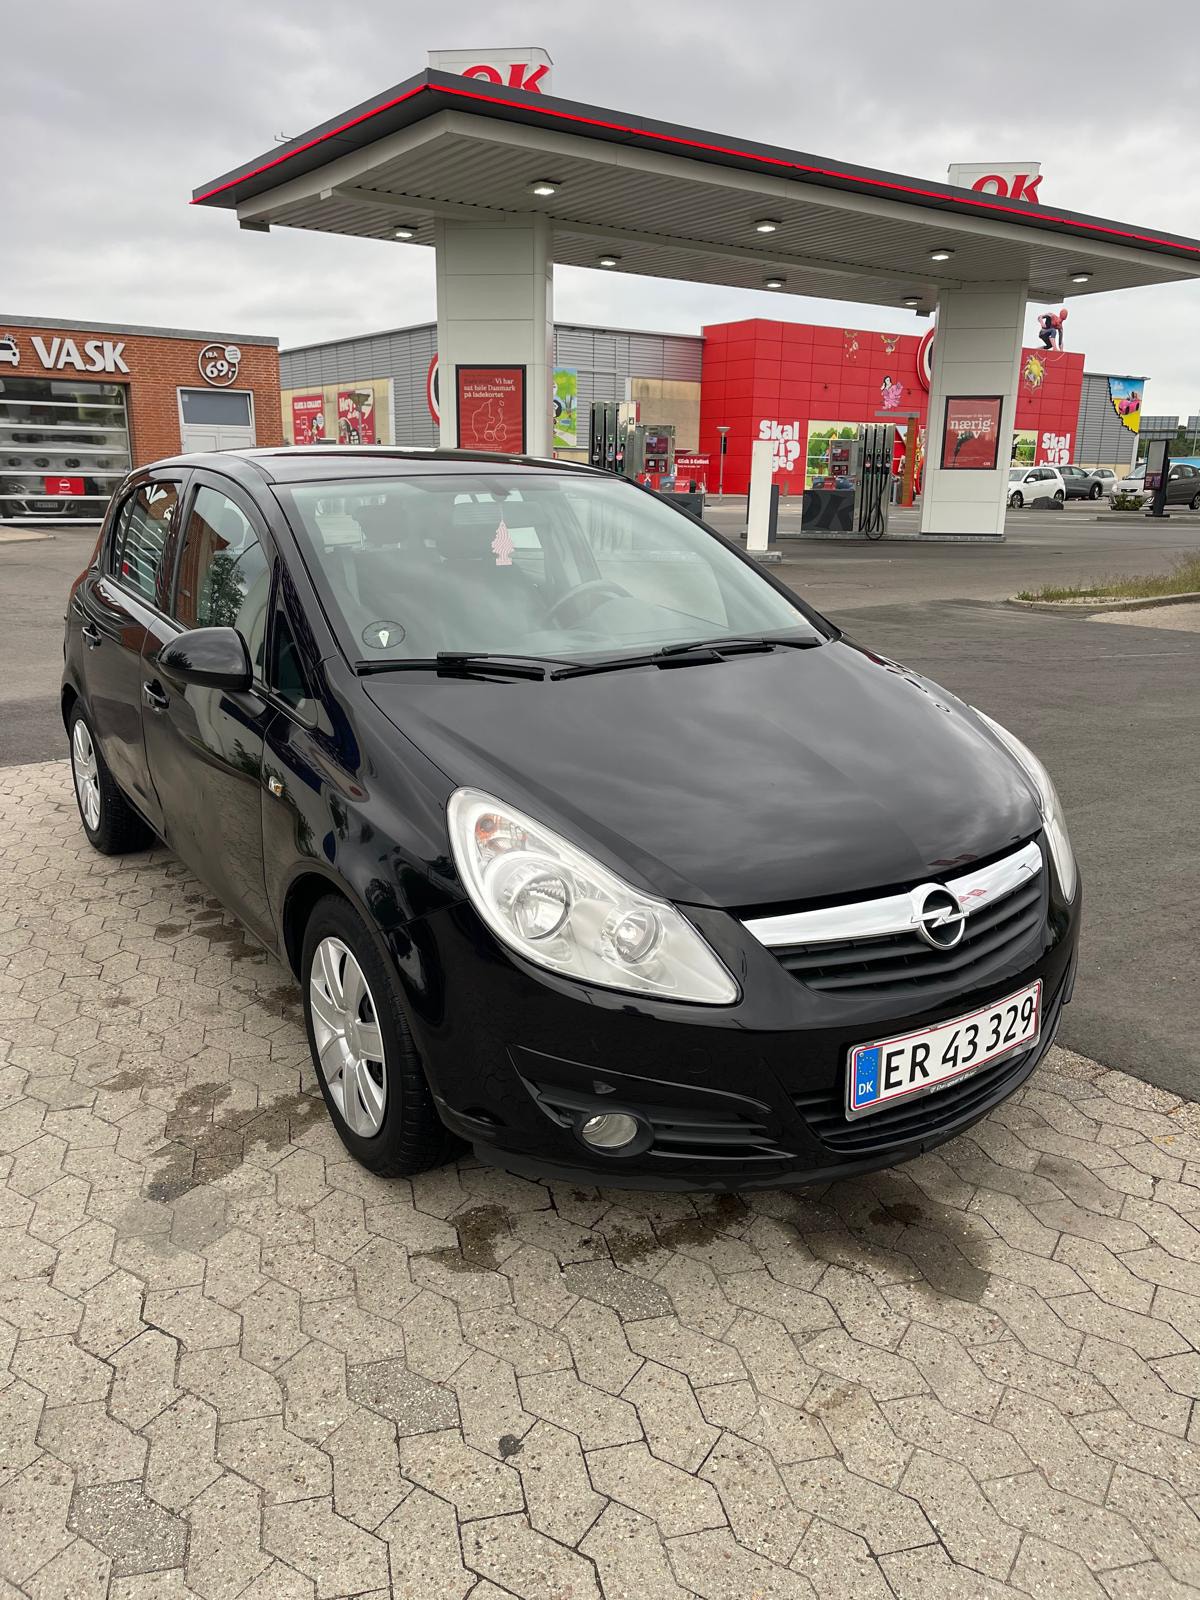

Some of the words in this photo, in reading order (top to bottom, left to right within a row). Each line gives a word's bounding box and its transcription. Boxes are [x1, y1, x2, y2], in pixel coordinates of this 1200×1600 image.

[971, 174, 1044, 205] OK
[30, 336, 130, 373] VASK
[487, 384, 516, 392] Danmark
[759, 419, 800, 440] Skal
[951, 417, 994, 432] nærig-
[1041, 432, 1070, 448] Skal
[884, 1042, 930, 1090] ER
[941, 1023, 979, 1068] 43
[986, 996, 1034, 1053] 329
[858, 1080, 874, 1096] DK
